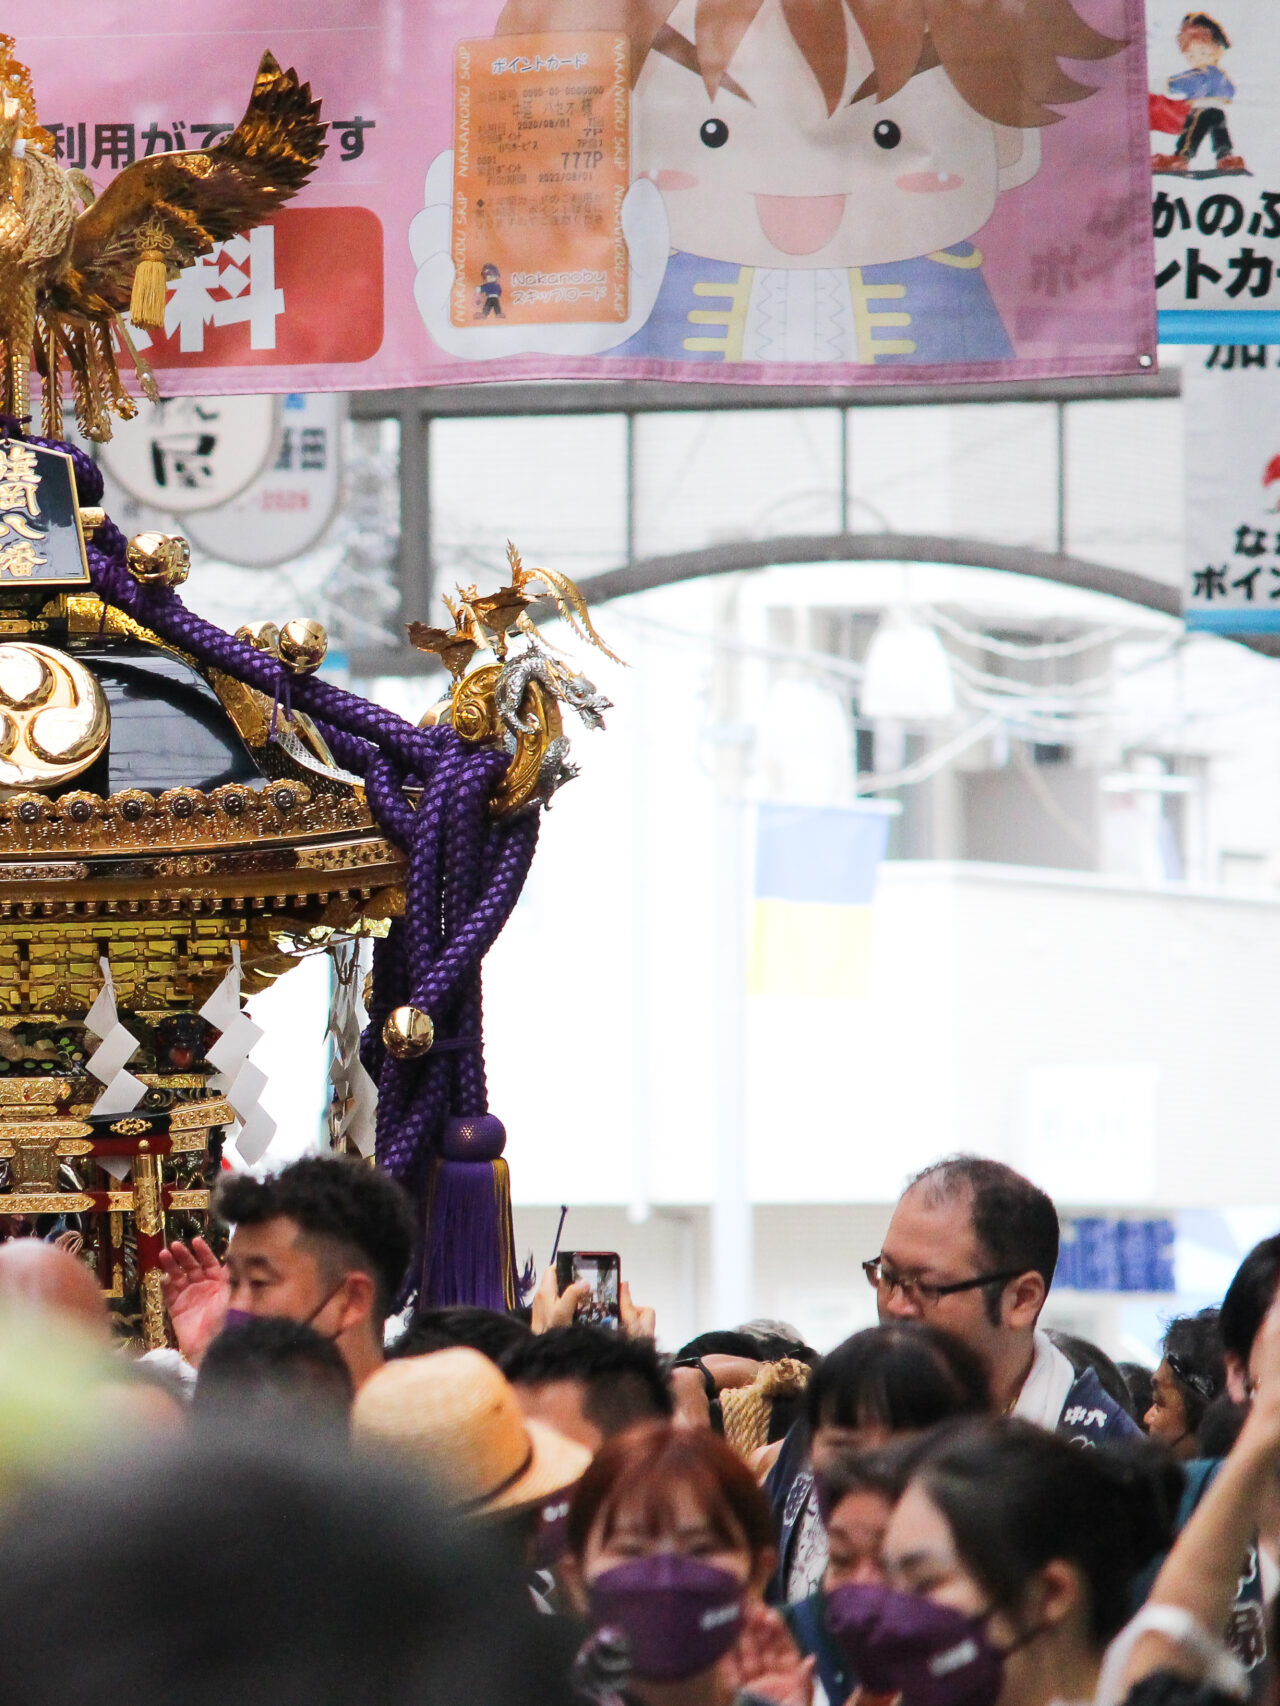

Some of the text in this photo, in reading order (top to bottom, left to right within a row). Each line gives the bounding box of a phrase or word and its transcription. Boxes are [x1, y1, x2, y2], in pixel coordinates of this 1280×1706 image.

[491, 53, 589, 75] ポイントカード
[456, 46, 471, 177] NAKANOBU SKIP
[561, 151, 605, 170] 777P
[511, 270, 608, 287] Nakanobu
[1233, 523, 1280, 557] な
[1192, 563, 1280, 601] ポイ
